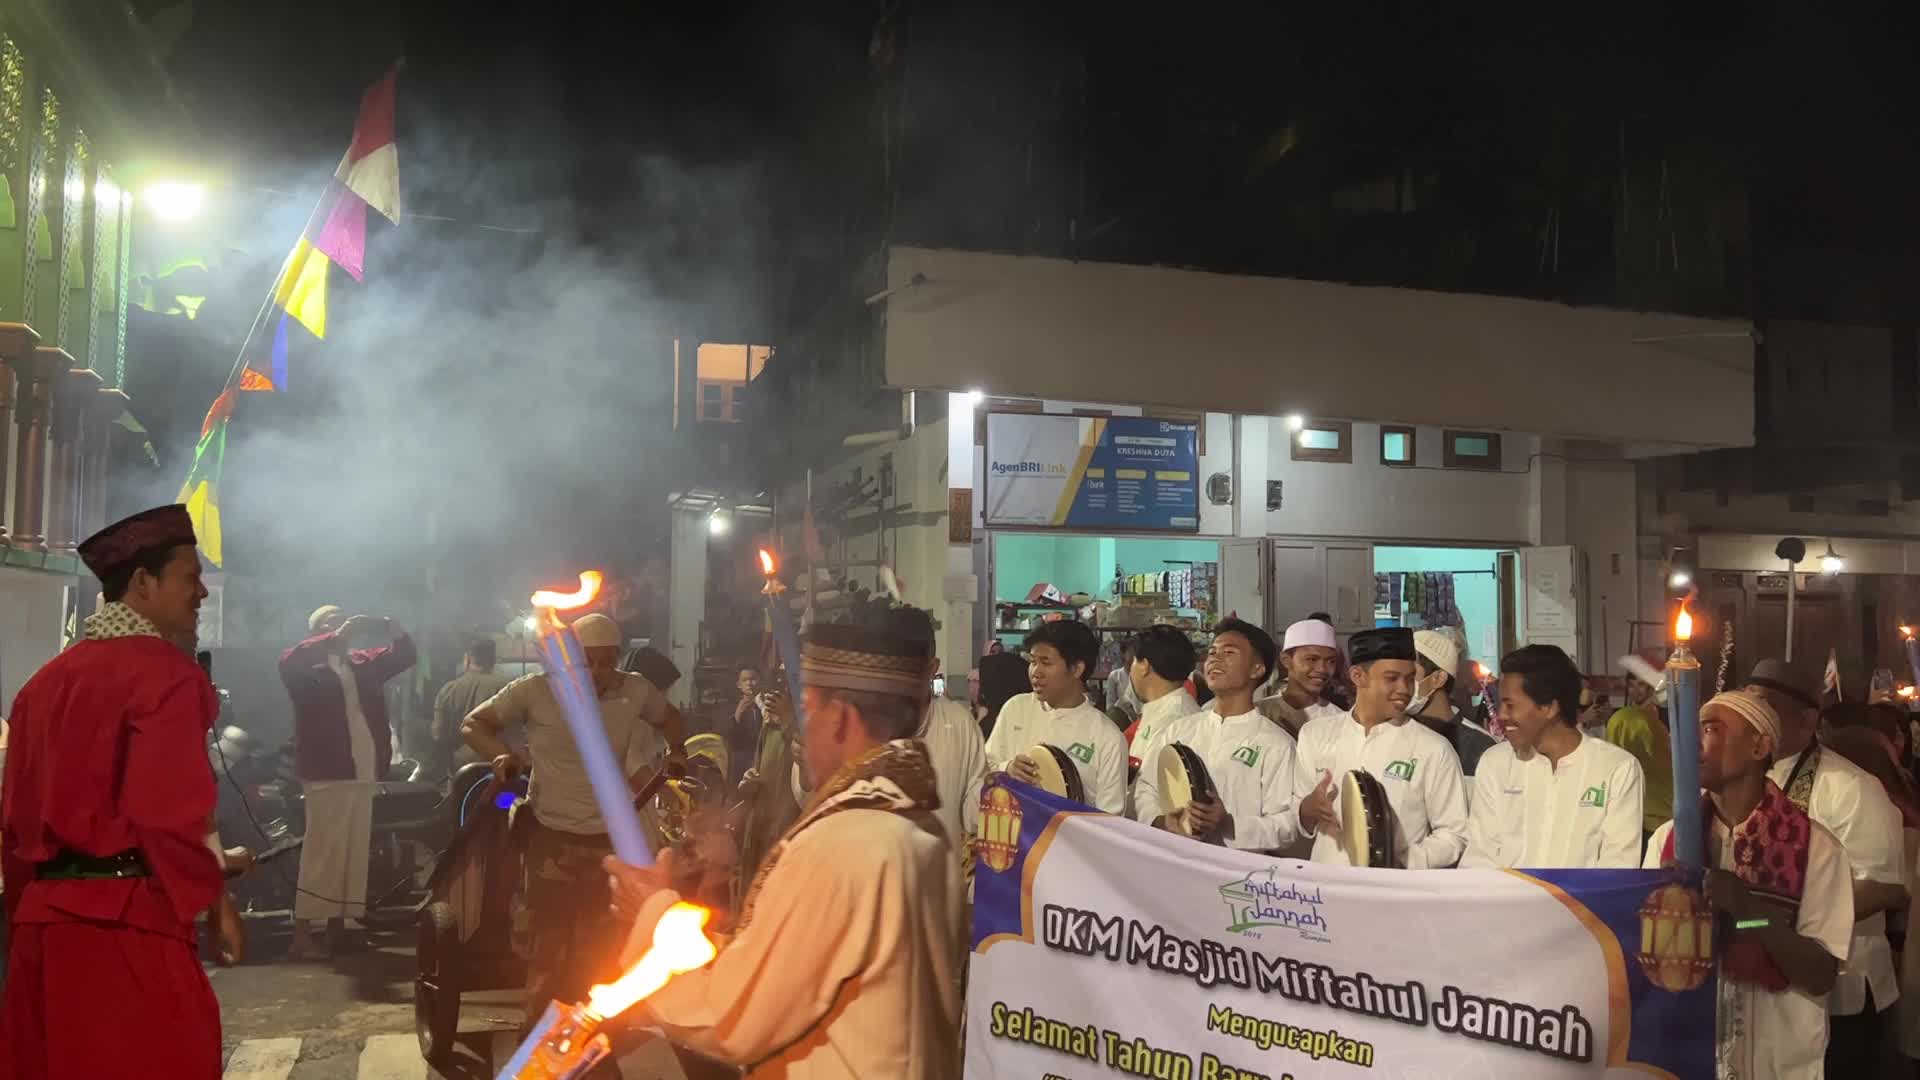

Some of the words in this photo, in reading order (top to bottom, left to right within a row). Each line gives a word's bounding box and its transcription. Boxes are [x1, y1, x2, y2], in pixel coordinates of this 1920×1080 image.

[1154, 449, 1176, 458] DUTA
[1249, 898, 1327, 932] Jannah
[1043, 904, 1124, 961] DKM
[1127, 916, 1251, 988] Masjid
[1253, 951, 1428, 1026] Miftahul
[1432, 986, 1593, 1063] Jannah
[990, 1001, 1099, 1062] Selamat
[1102, 1030, 1193, 1080] Tahun
[1207, 1003, 1374, 1067] Mengucapkan
